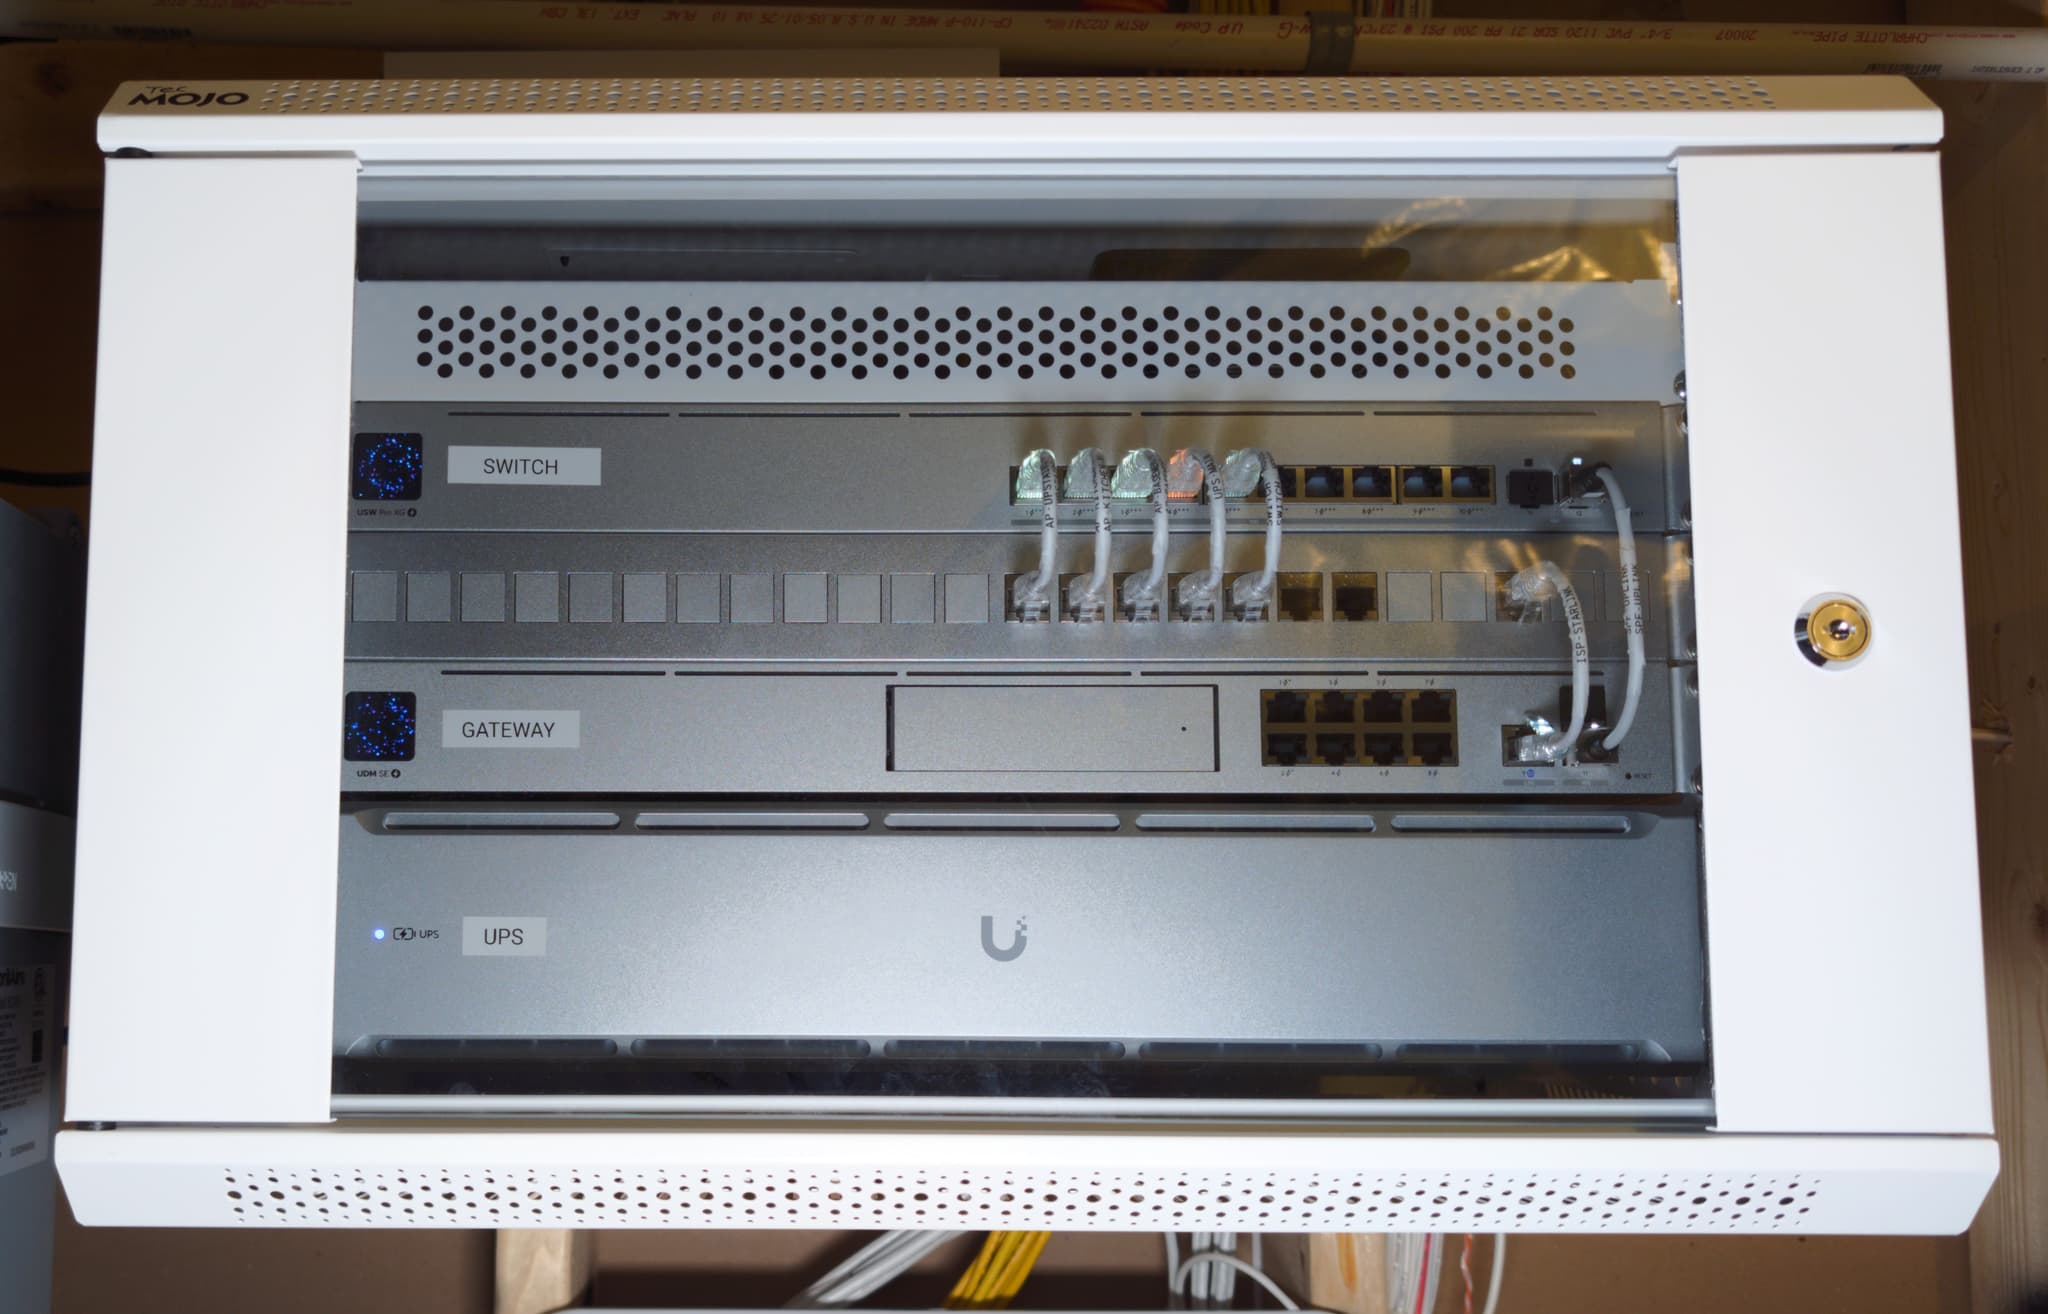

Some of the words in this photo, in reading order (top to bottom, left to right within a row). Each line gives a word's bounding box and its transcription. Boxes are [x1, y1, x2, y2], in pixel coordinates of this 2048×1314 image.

[880, 15, 896, 26] IN
[1114, 20, 1152, 31] ASTM
[1175, 21, 1211, 34] Code
[1421, 24, 1447, 36] PSI
[1454, 25, 1479, 37] 200
[1566, 26, 1600, 39] 1120
[1606, 27, 1633, 39] PVC
[1714, 29, 1759, 41] 20007
[1854, 31, 1929, 44] CHARLOTTE
[128, 92, 249, 107] MOJO
[483, 458, 559, 475] SWITCH
[1562, 586, 1587, 663] ISP-STARLINK
[461, 721, 555, 738] GATEWAY
[356, 769, 377, 777] UDM
[419, 929, 439, 939] UPS
[483, 928, 524, 946] UPS
